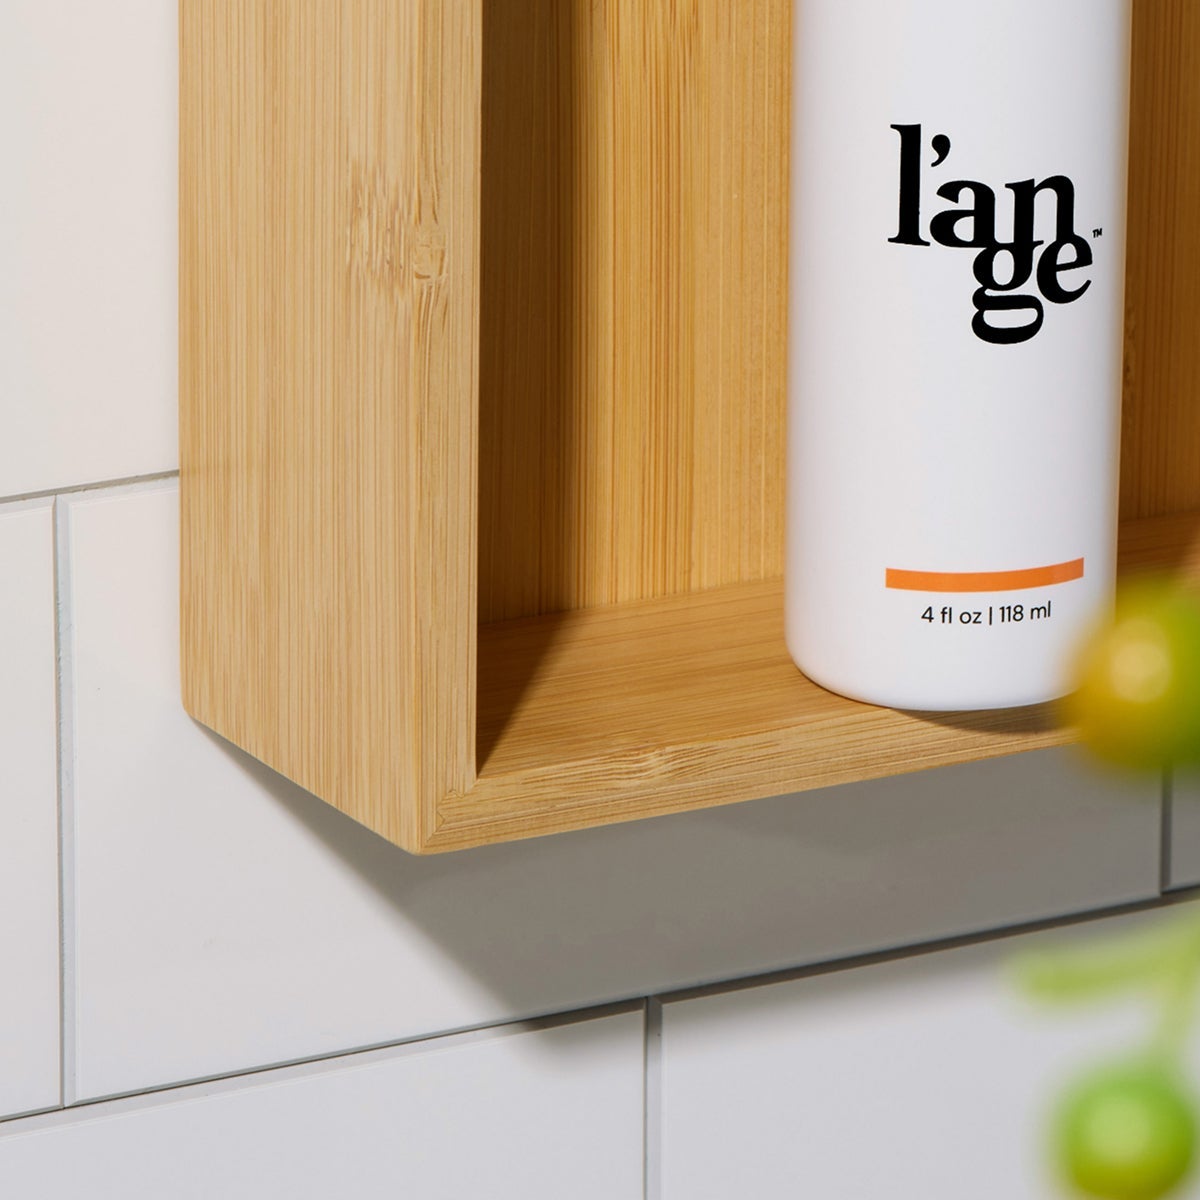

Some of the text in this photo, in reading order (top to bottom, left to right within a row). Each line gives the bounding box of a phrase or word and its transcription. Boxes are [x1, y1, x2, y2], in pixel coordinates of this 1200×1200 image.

[920, 606, 935, 623] 4
[939, 606, 953, 624] fl
[959, 611, 982, 625] oz
[999, 604, 1024, 623] 118
[1030, 599, 1052, 620] ml
